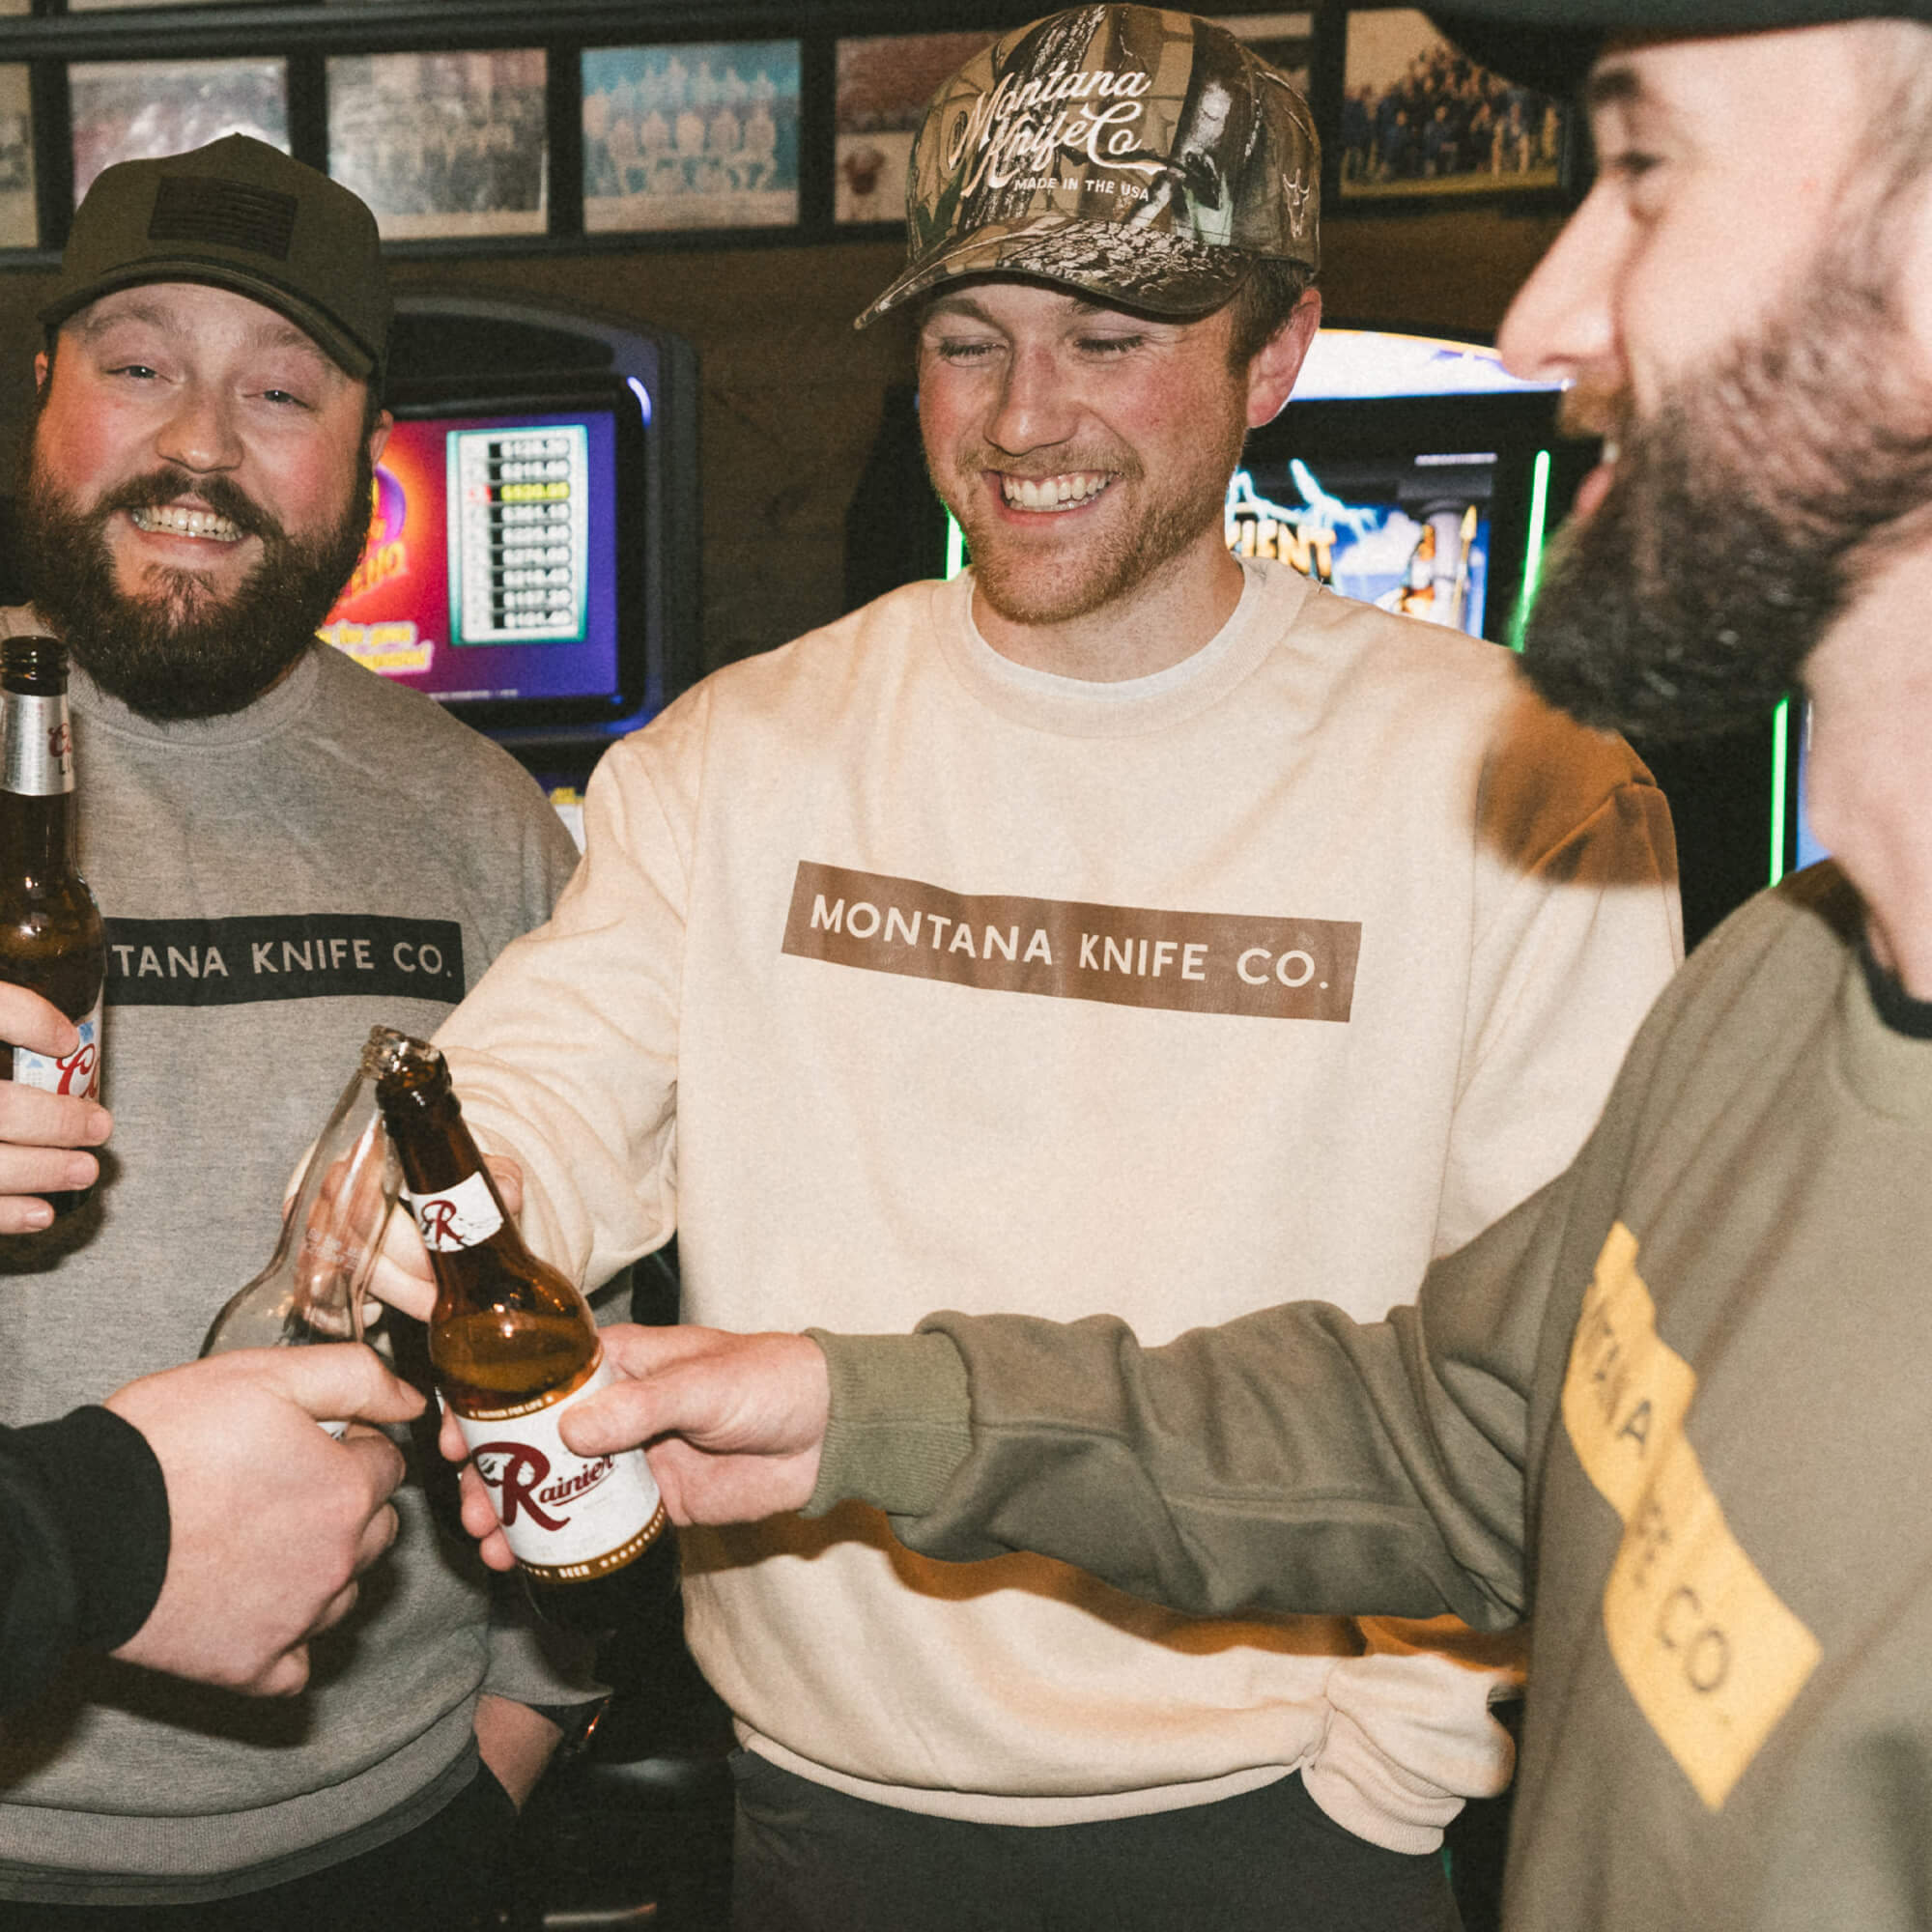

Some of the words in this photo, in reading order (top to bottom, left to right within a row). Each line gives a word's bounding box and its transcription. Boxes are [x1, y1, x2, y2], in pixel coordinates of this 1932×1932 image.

[949, 60, 1152, 171] Montana
[960, 110, 1088, 198] Knife
[1079, 100, 1168, 176] Co
[1014, 177, 1060, 191] MADE
[1063, 178, 1079, 191] IN
[1084, 179, 1116, 195] THE
[1120, 181, 1151, 202] USA
[111, 944, 230, 979] TANA
[250, 938, 375, 975] KNIFE
[392, 941, 453, 979] CO.
[810, 893, 1053, 966] MONTANA
[1078, 932, 1208, 981] KNIFE
[1236, 947, 1329, 990] CO.
[470, 1440, 614, 1532] Rainier
